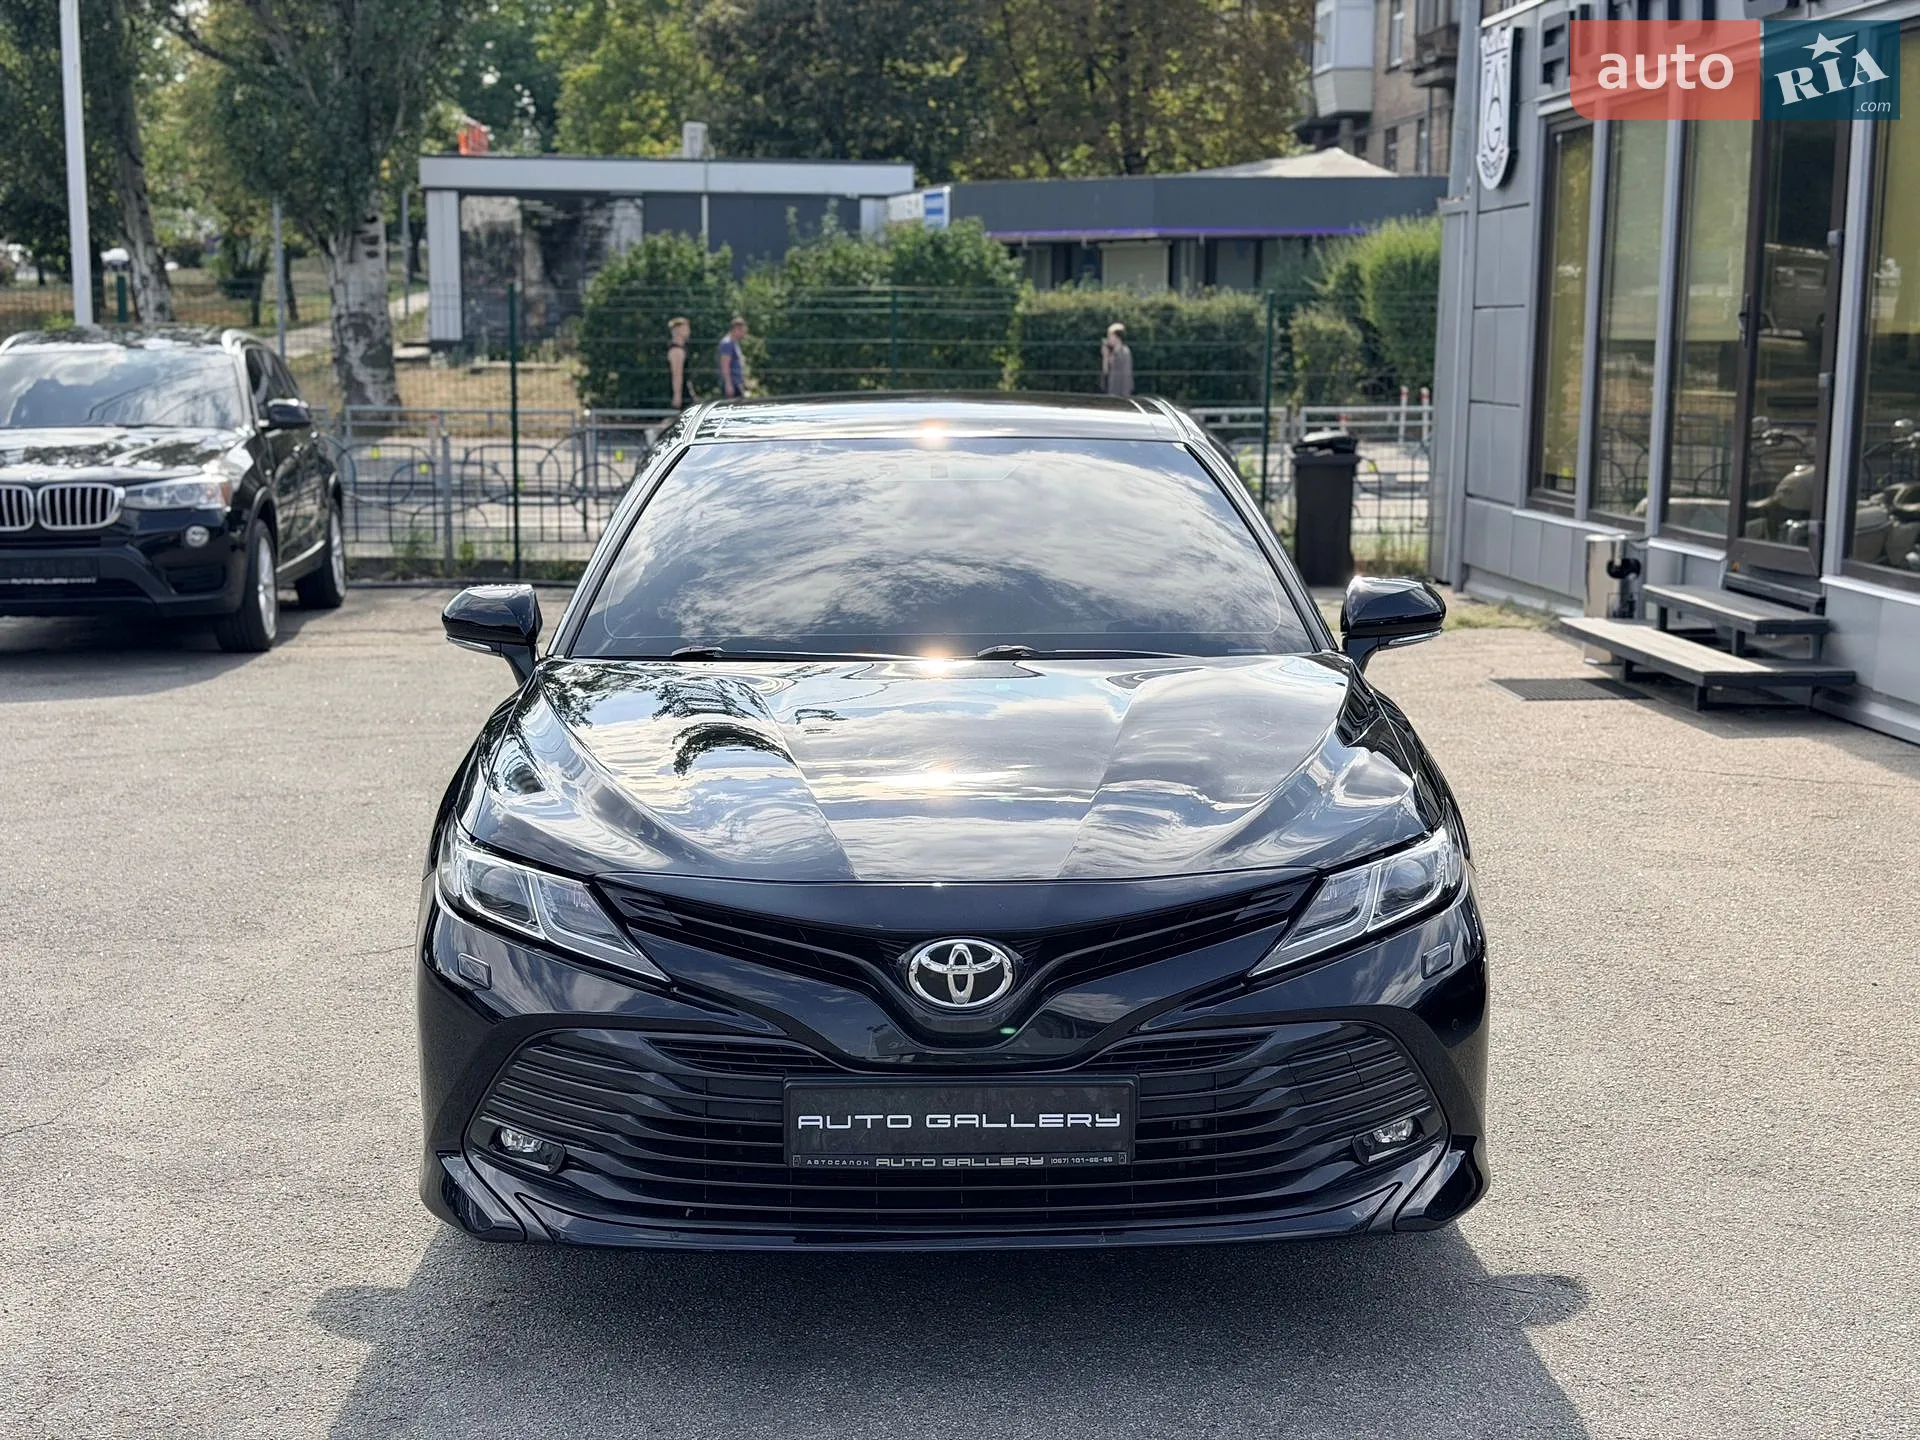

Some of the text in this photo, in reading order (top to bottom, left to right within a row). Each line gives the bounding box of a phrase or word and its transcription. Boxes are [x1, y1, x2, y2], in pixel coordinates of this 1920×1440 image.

[797, 1112, 1121, 1130] AUTO GALLERY
[875, 1157, 937, 1167] AUTO
[942, 1156, 1044, 1167] GALLERY
